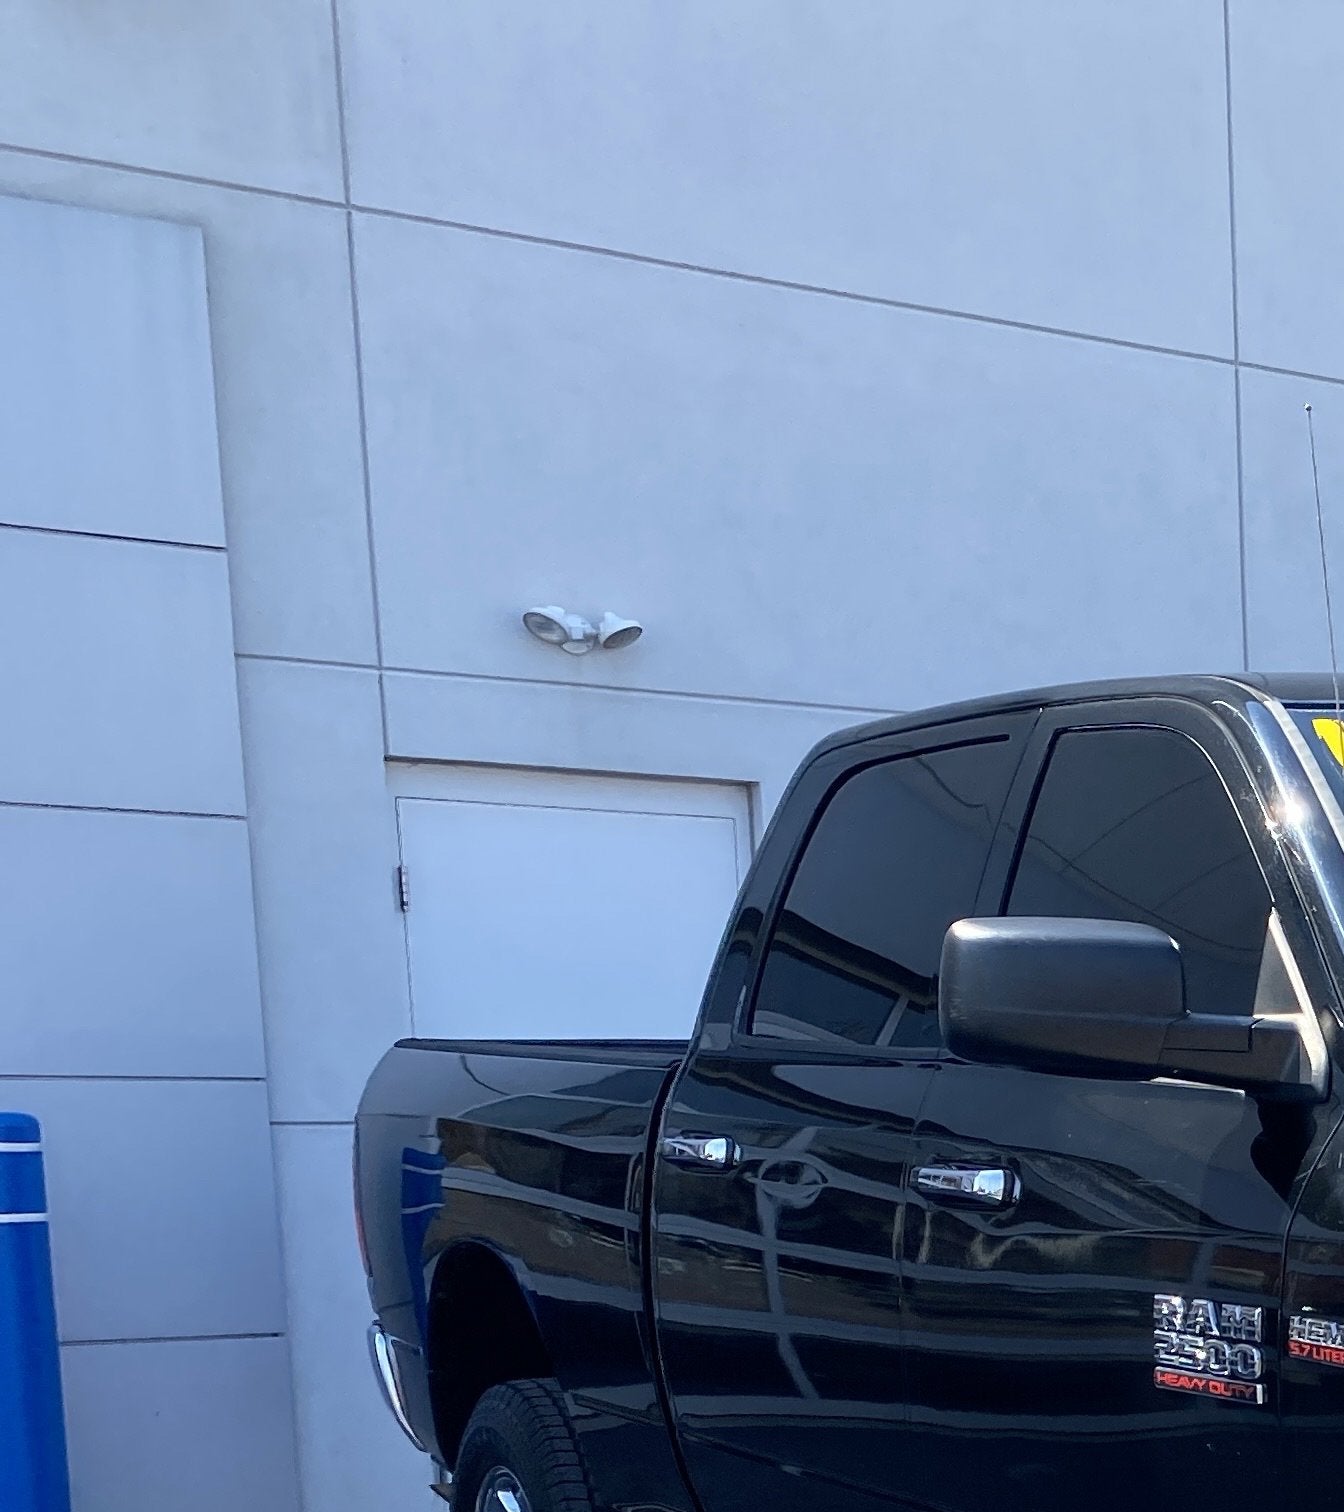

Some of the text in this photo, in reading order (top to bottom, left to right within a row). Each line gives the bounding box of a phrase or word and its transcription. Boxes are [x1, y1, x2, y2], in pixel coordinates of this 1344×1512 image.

[1153, 1294, 1262, 1342] RAM
[1153, 1329, 1262, 1379] 2500
[1157, 1371, 1255, 1398] HEAVY DUTY
